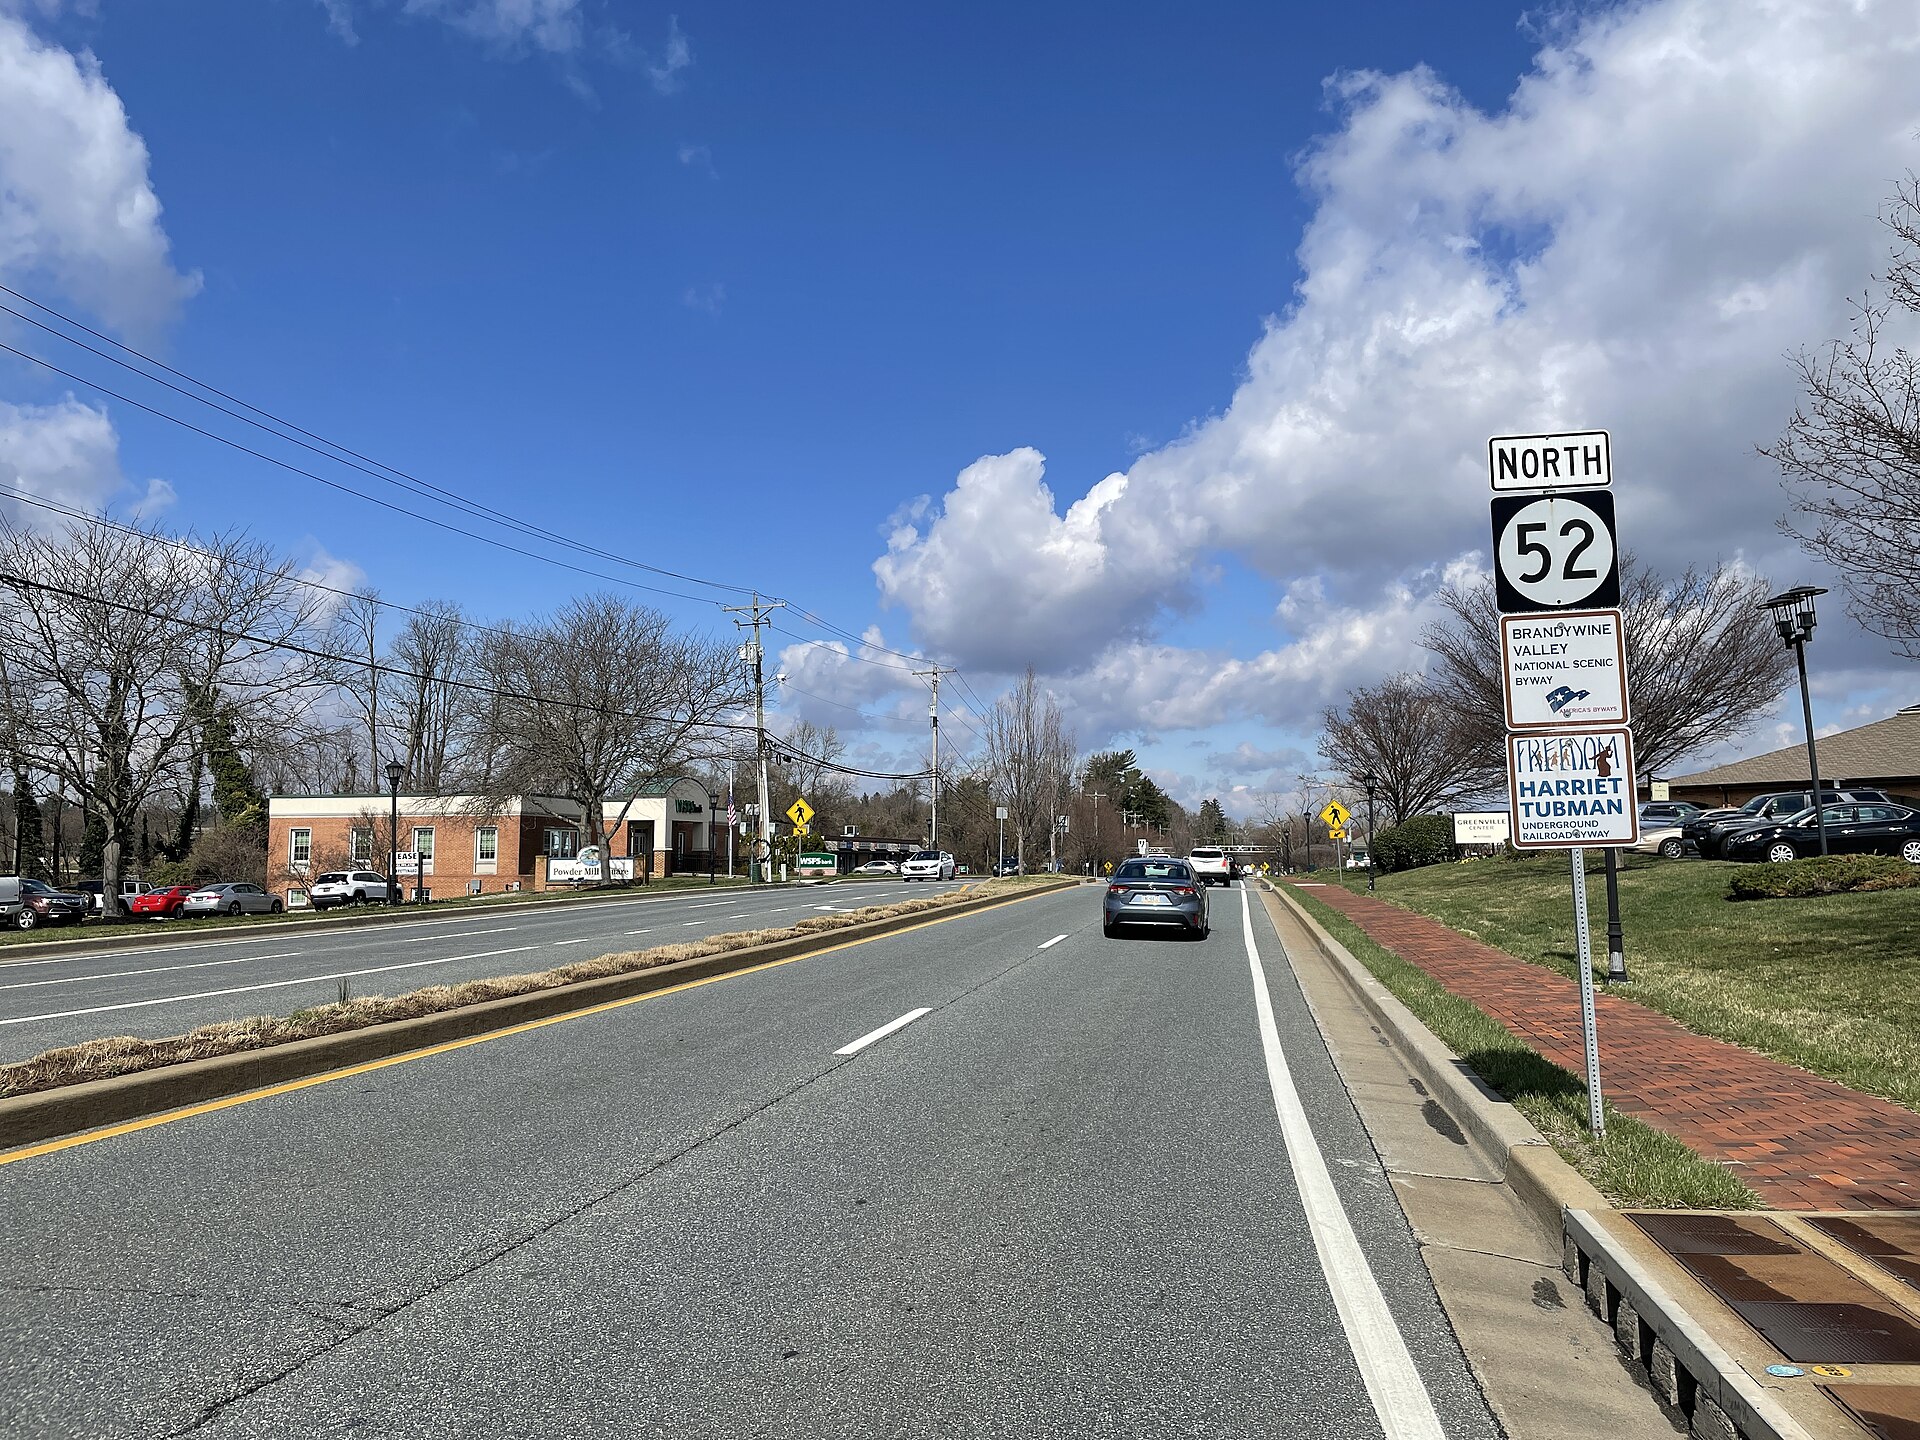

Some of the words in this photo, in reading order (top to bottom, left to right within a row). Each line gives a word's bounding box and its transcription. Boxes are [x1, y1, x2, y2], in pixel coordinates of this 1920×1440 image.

[1498, 444, 1602, 480] NORTH
[1516, 518, 1598, 584] 52
[1512, 623, 1612, 640] BRANDYWINE
[1513, 643, 1568, 657] VALLEY
[1514, 660, 1570, 671] NATIONAL
[1572, 658, 1613, 669] SCENIC
[1515, 675, 1553, 686] BYWAY
[1592, 705, 1618, 713] BYWAYS
[1519, 777, 1623, 798] HARRIET
[1519, 798, 1623, 818] TUBMAN
[1457, 818, 1507, 826] GREENVILLE
[1522, 820, 1599, 830] UNDERGROUND
[1522, 831, 1573, 840] RAILROAD
[397, 852, 418, 860] EASE
[800, 857, 821, 865] WSFS
[553, 867, 583, 876] Powder
[584, 867, 600, 876] Mill
[611, 868, 629, 876] uare
